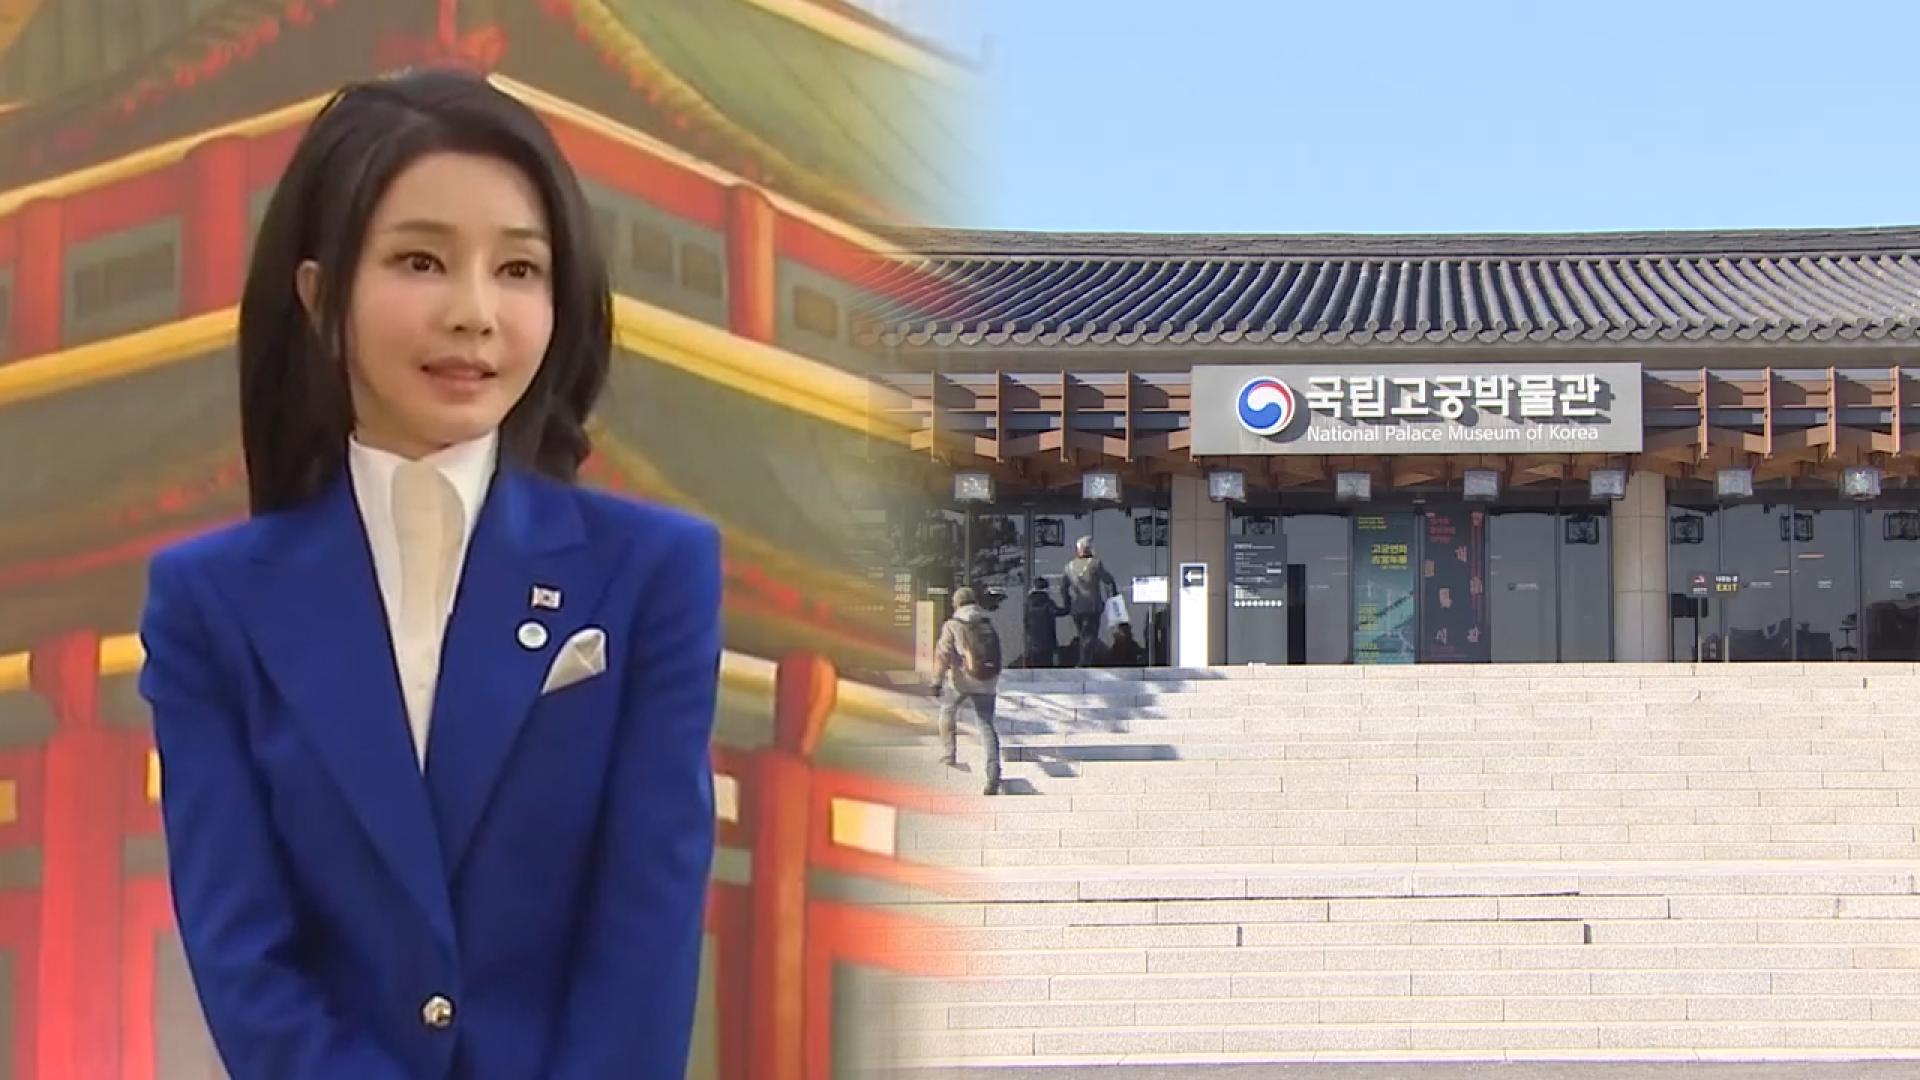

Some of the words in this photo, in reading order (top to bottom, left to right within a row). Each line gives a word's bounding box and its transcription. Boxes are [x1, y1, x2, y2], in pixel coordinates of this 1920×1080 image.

[1306, 374, 1600, 419] 국립고궁박물관
[1307, 425, 1378, 442] National
[1385, 425, 1442, 441] Palace
[1449, 425, 1520, 441] Museum
[1526, 423, 1544, 441] of
[1550, 424, 1599, 441] Korea
[1715, 583, 1738, 592] EXIT
